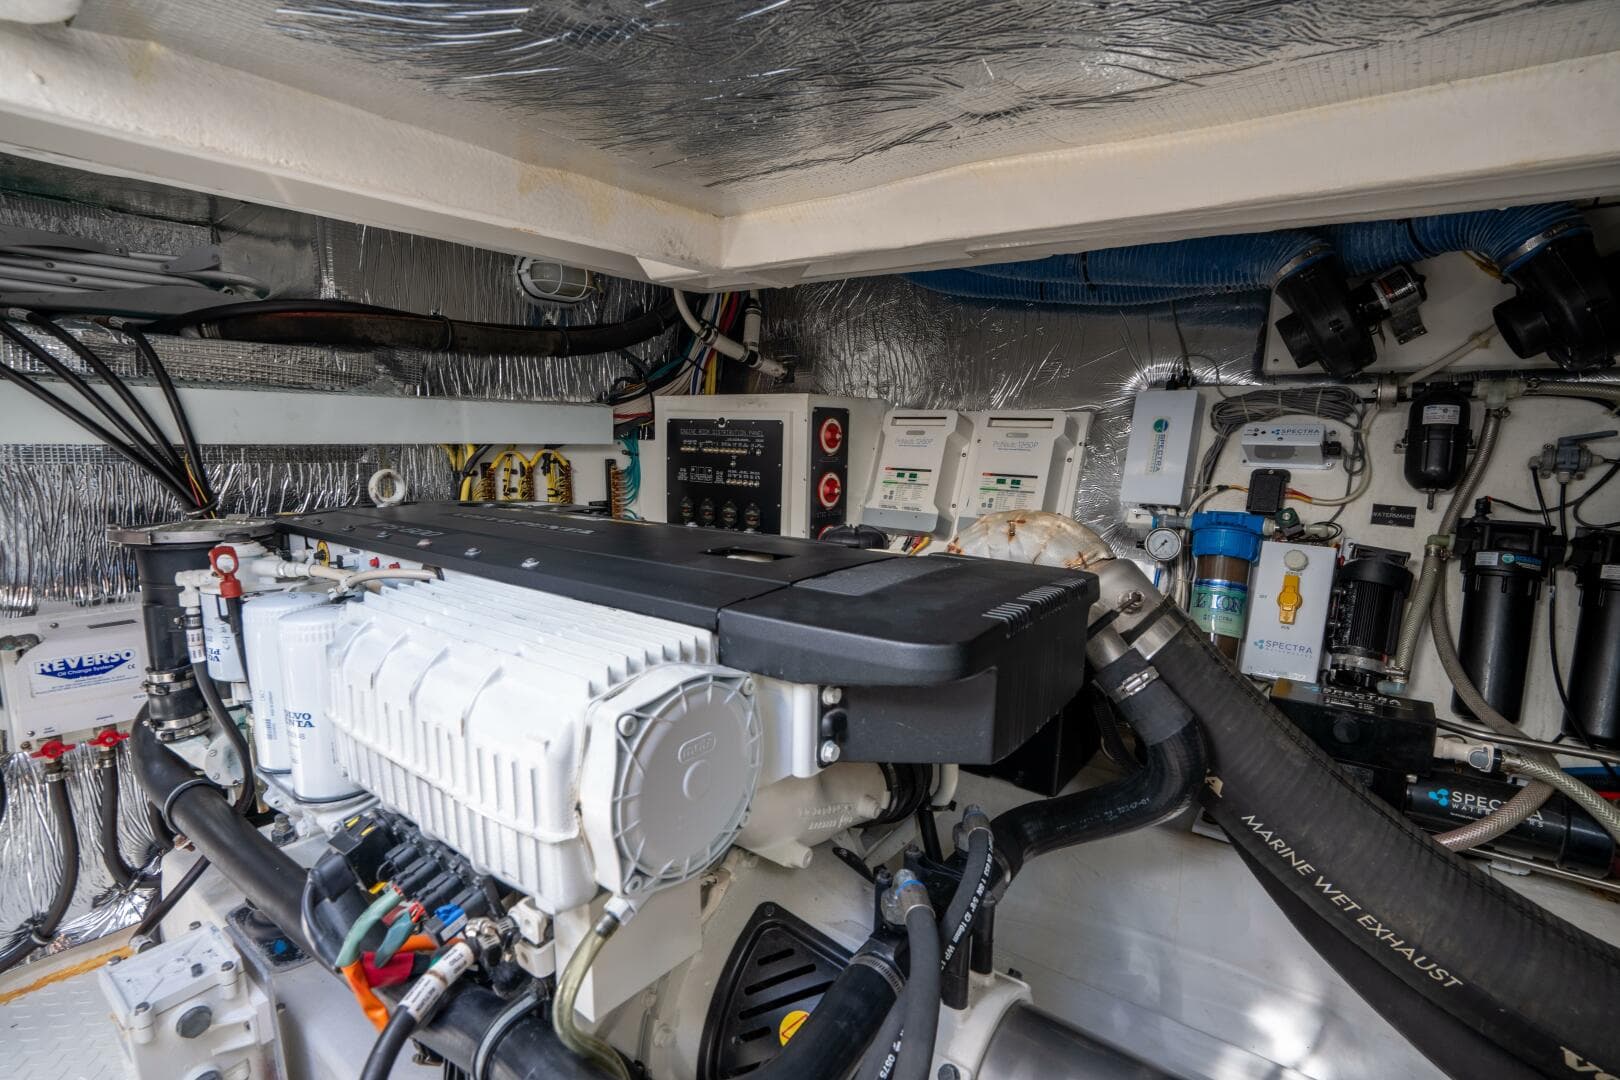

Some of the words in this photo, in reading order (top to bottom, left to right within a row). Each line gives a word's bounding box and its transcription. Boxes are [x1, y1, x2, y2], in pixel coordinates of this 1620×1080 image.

[1265, 640, 1313, 654] SPECTRA
[35, 649, 135, 674] REVERSO
[67, 667, 92, 676] Change
[93, 664, 114, 672] System
[1241, 814, 1316, 876] MARINE
[1312, 874, 1362, 912] WET
[1356, 913, 1465, 989] EXHAUST
[944, 944, 956, 961] WP
